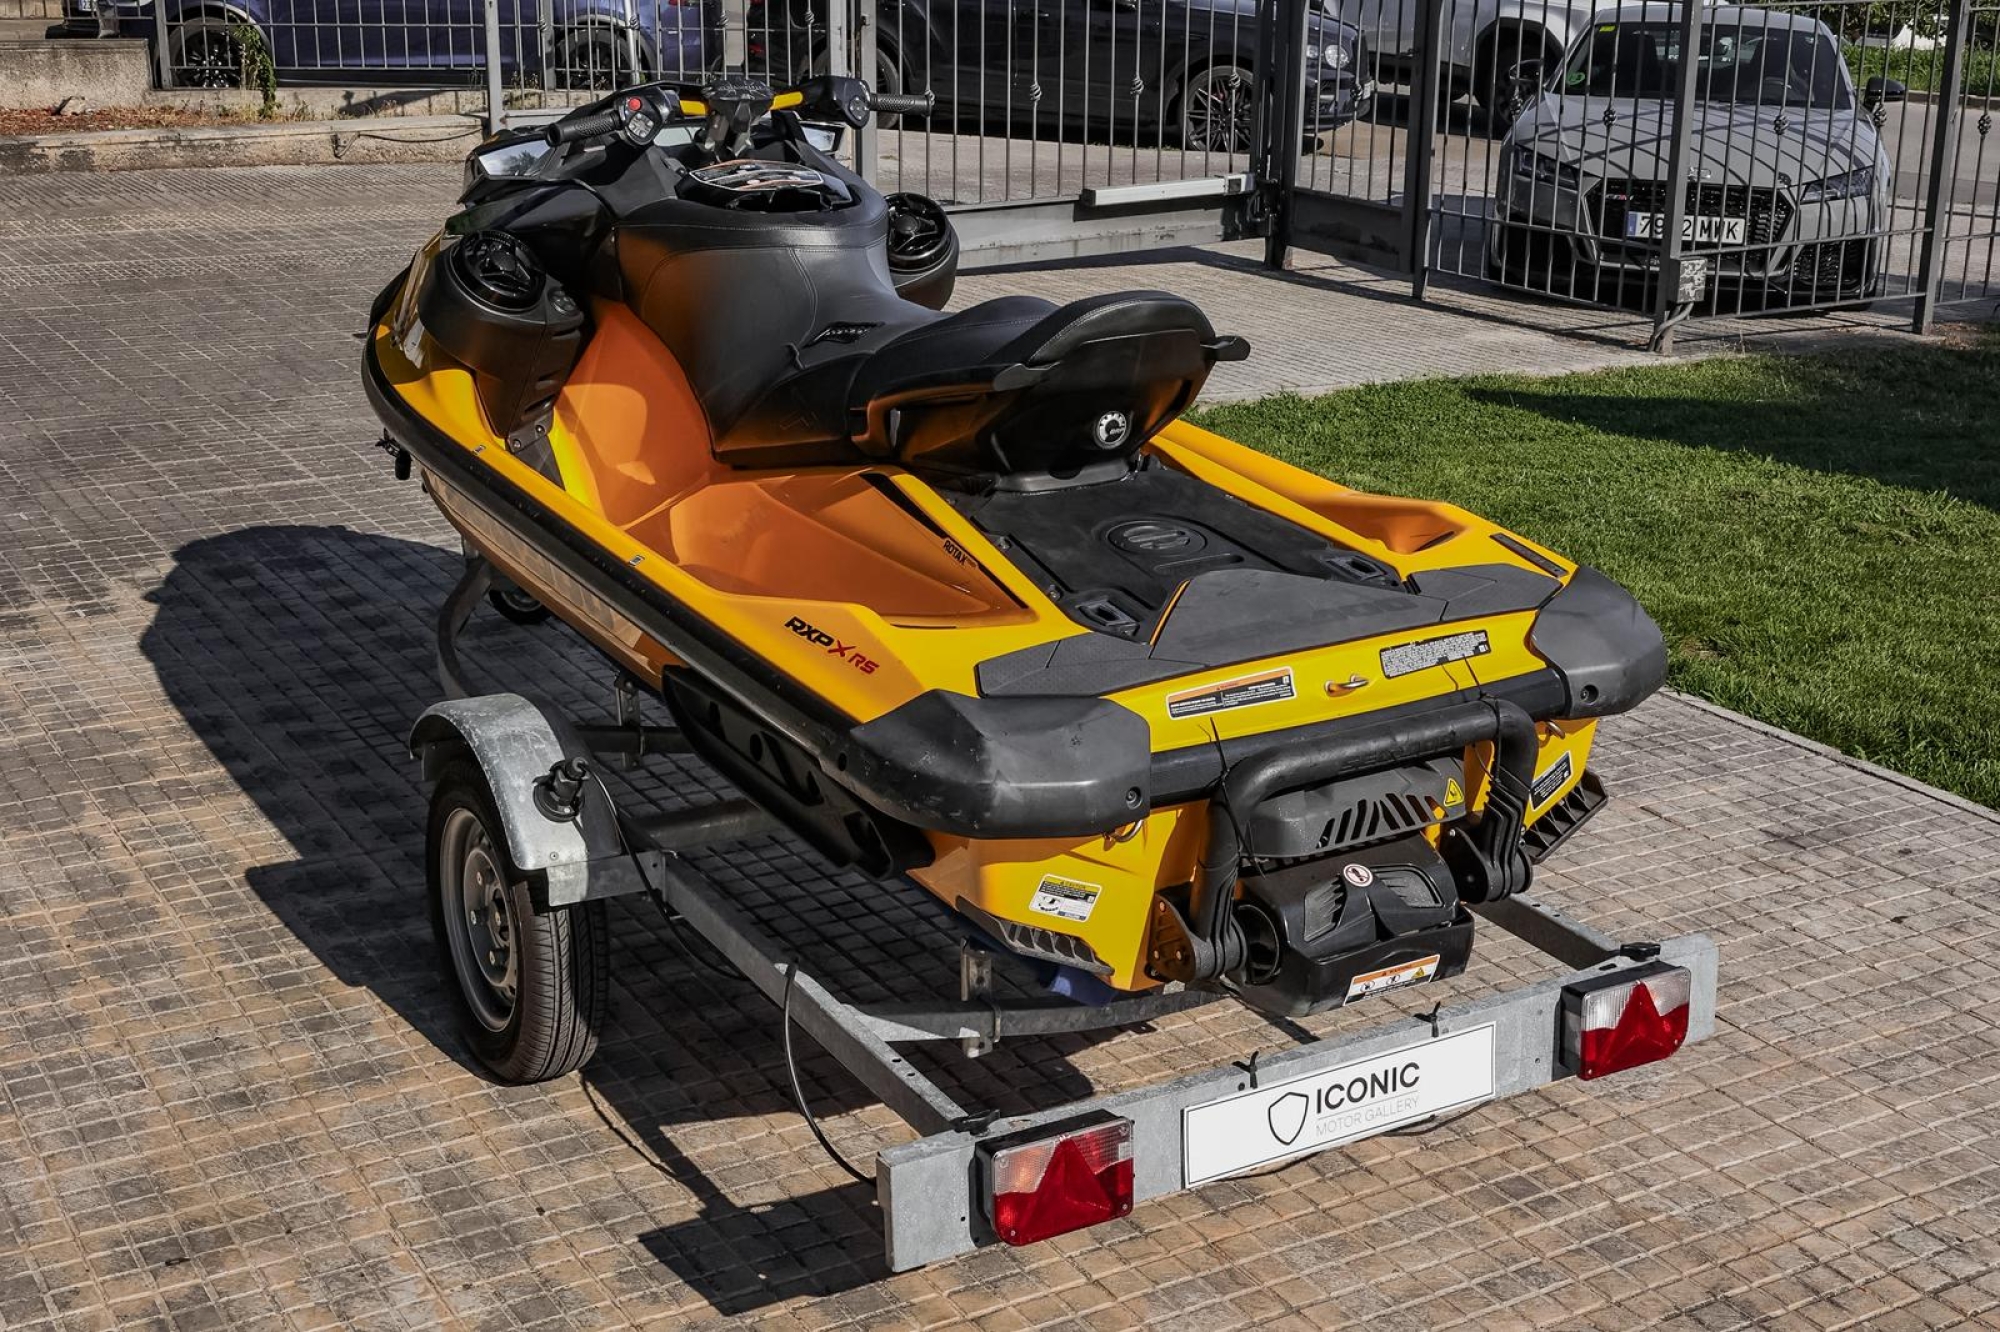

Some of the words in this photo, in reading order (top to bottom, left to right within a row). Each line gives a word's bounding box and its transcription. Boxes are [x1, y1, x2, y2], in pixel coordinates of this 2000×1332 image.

[1640, 215, 1692, 237] 792
[943, 539, 968, 565] ROTAX
[848, 653, 880, 675] RS
[1317, 1062, 1420, 1113] ICONIC
[1317, 1113, 1361, 1136] MOTOR
[1365, 1097, 1419, 1121] GALLERY
